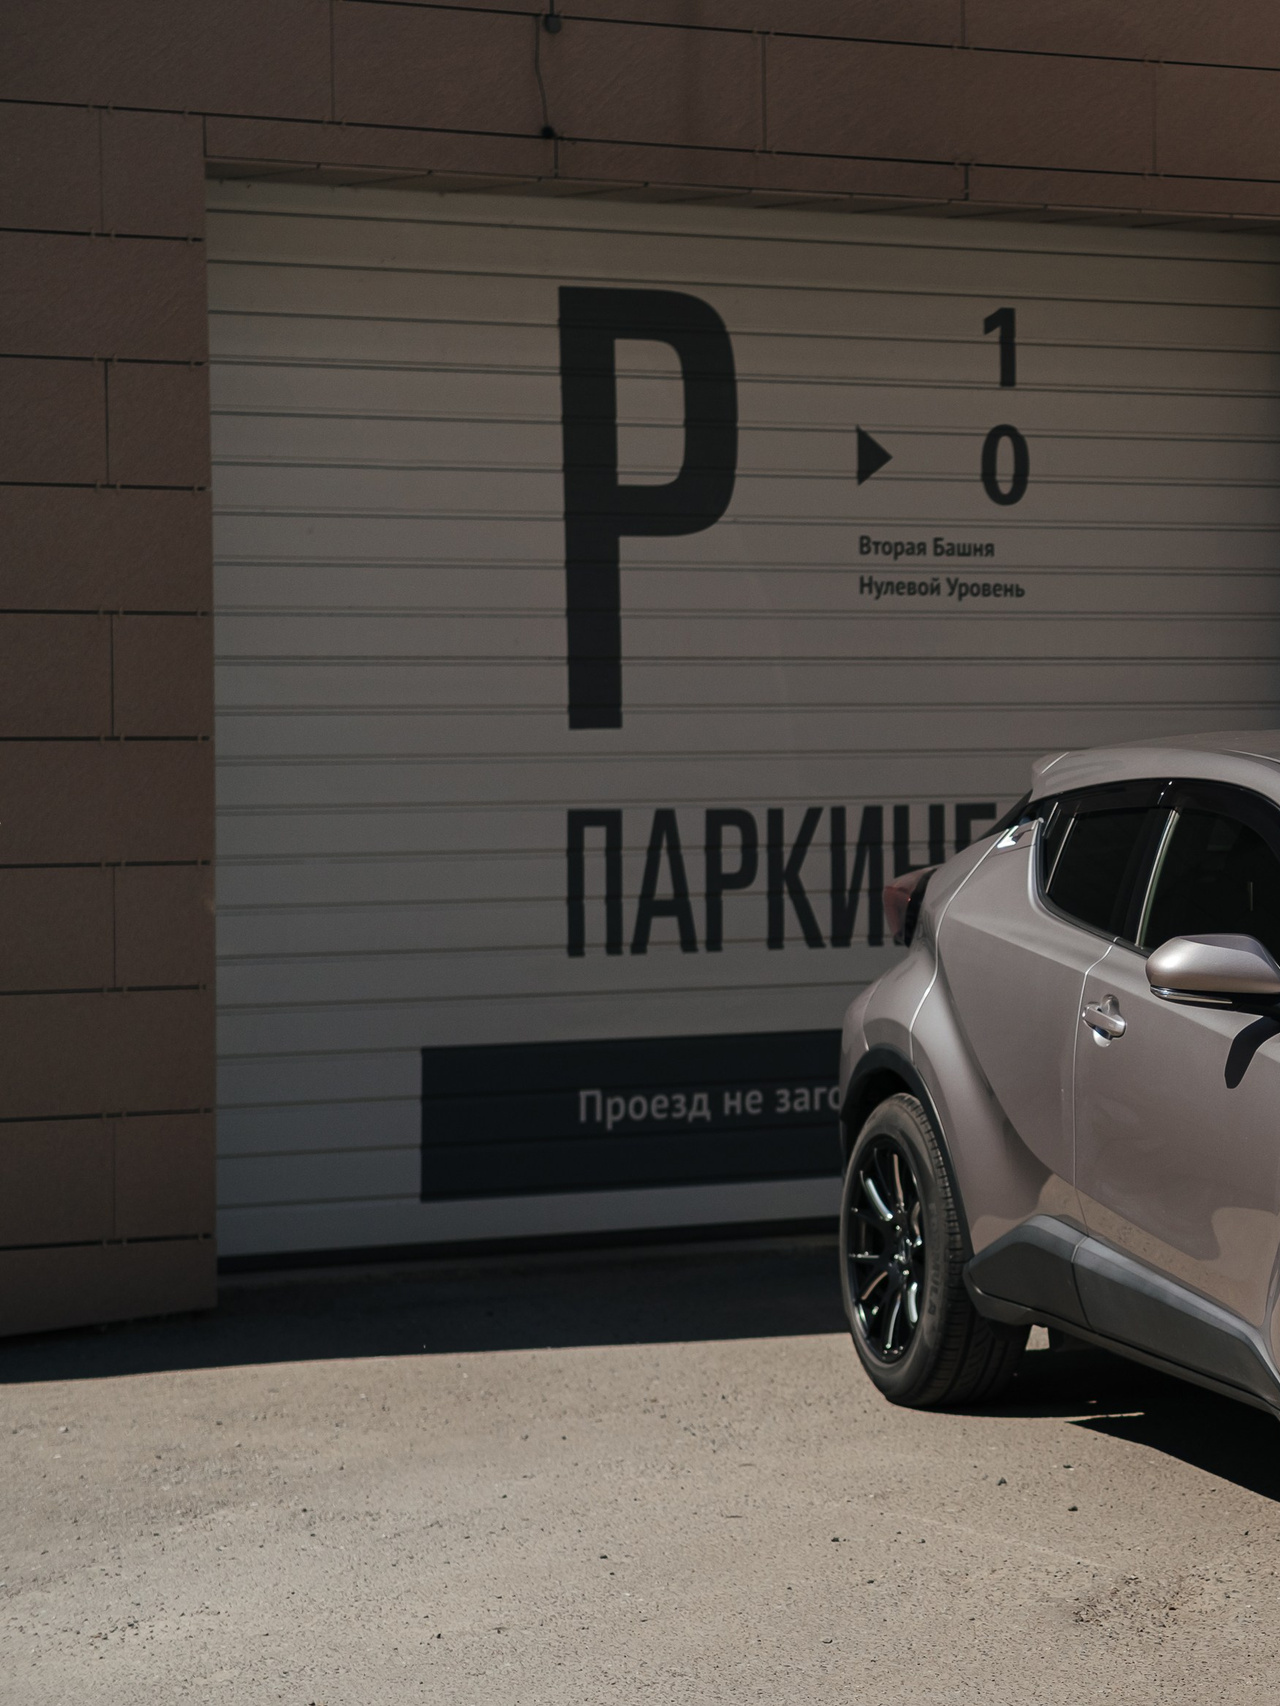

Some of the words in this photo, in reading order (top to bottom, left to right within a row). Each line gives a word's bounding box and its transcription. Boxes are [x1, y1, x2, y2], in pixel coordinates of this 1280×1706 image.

[983, 307, 1016, 387] 1
[981, 423, 1030, 506] 0
[859, 536, 927, 561] Вторая
[932, 537, 995, 558] Башня
[859, 574, 942, 601] Нулевой
[946, 577, 1026, 600] Уровень
[579, 1089, 712, 1132] Проезд
[724, 1087, 763, 1116] не
